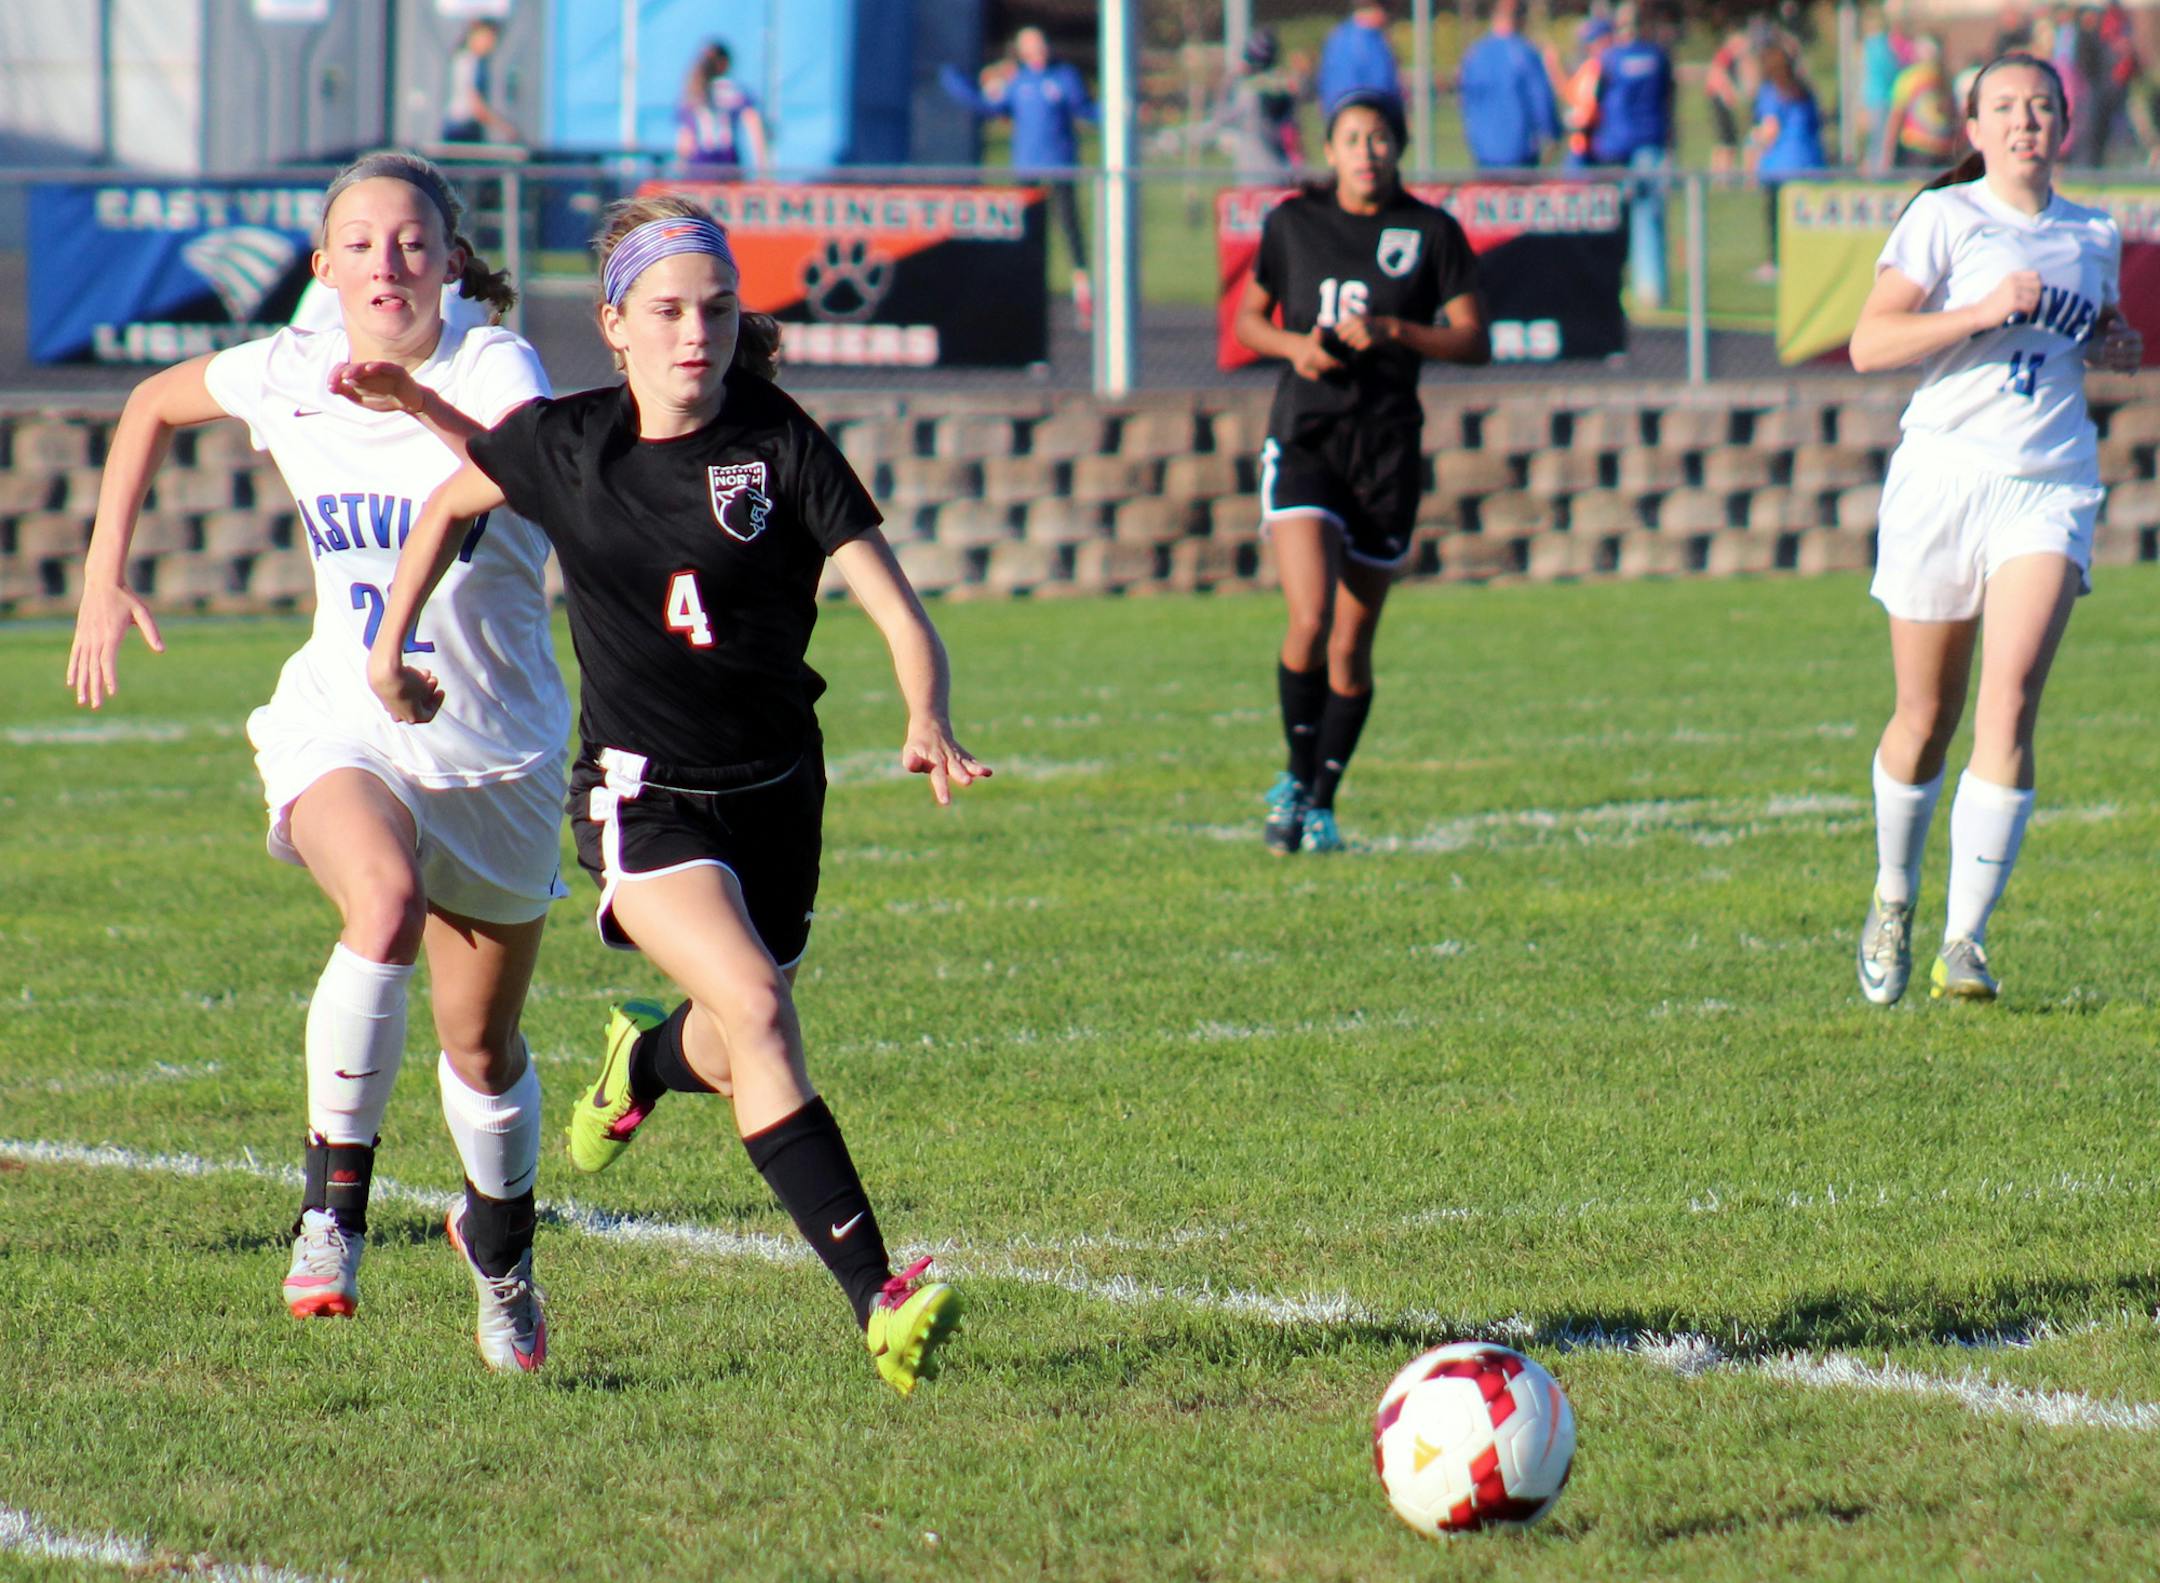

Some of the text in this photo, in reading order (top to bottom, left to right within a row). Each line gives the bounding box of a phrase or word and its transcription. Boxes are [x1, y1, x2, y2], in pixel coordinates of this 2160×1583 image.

[96, 189, 324, 229] EASTVIE
[700, 187, 1024, 238] ARMINGTON
[664, 569, 715, 647] 4
